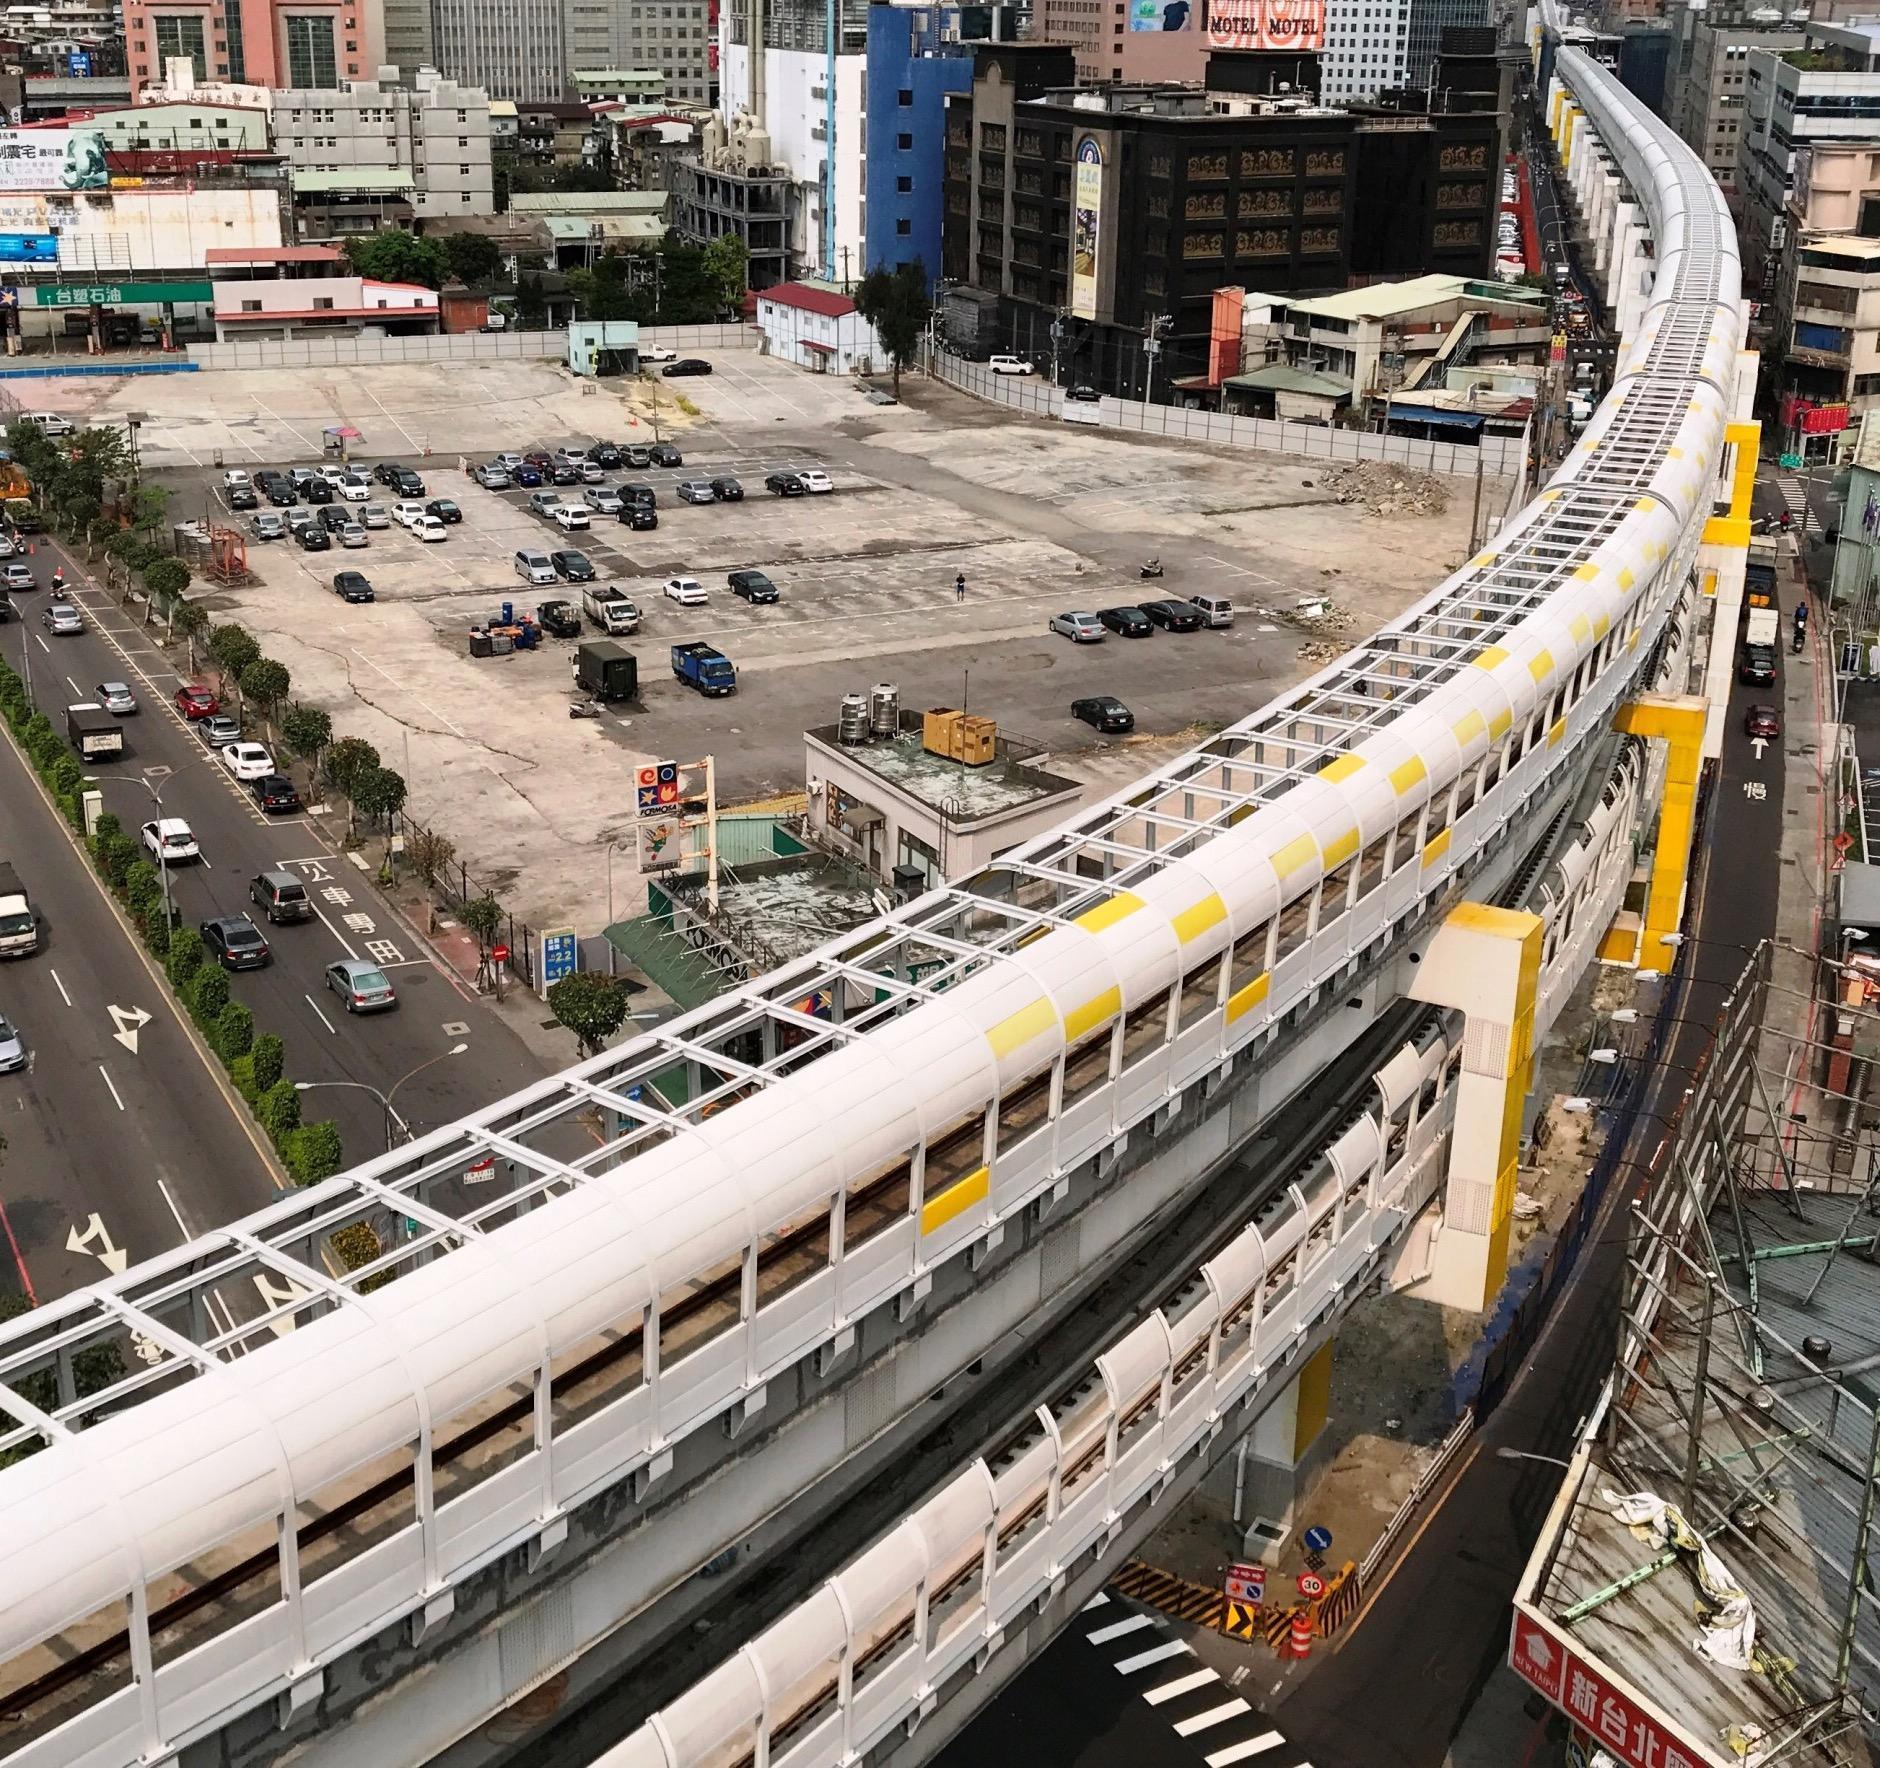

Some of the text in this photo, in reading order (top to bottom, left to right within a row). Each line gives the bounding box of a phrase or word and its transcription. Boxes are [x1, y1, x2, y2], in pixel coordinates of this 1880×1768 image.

[1210, 16, 1318, 35] MOTEL MOTEL
[56, 287, 122, 303] 台塑石油
[1743, 782, 1766, 800] 慢
[640, 804, 677, 816] FORMOSA
[1304, 1580, 1320, 1590] 30
[1515, 1654, 1534, 1673] NEW
